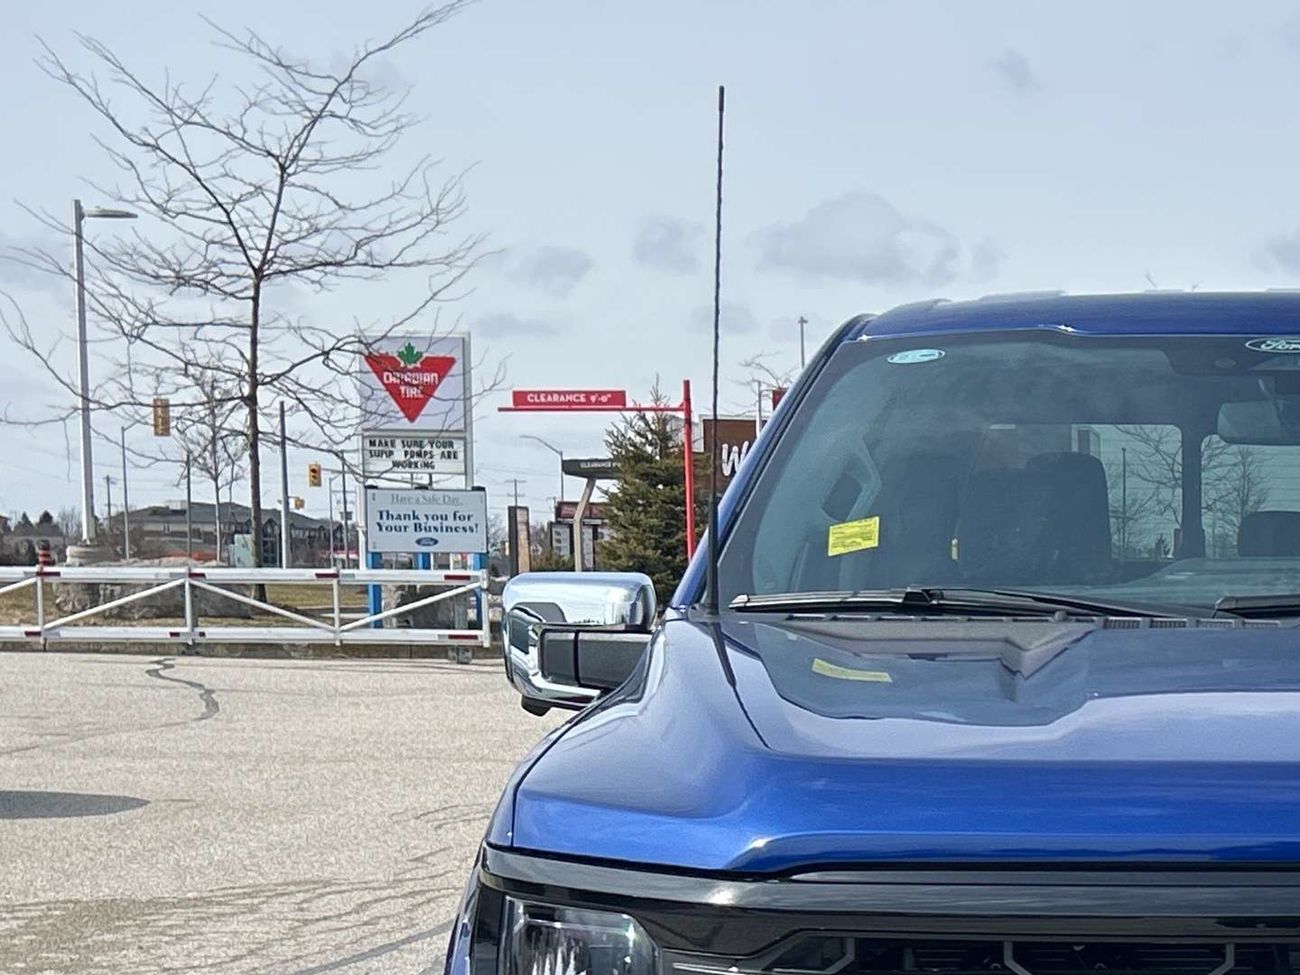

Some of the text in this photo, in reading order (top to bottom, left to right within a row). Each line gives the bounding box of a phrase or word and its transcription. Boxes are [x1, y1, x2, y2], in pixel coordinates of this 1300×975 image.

[527, 393, 586, 403] CLEARANCE
[369, 440, 454, 449] MAKE SURE YOUR
[369, 449, 459, 460] SUMP PUMPS ARE
[392, 460, 436, 470] WORKING
[378, 510, 474, 523] Thank you for
[377, 521, 479, 533] Your Business!
